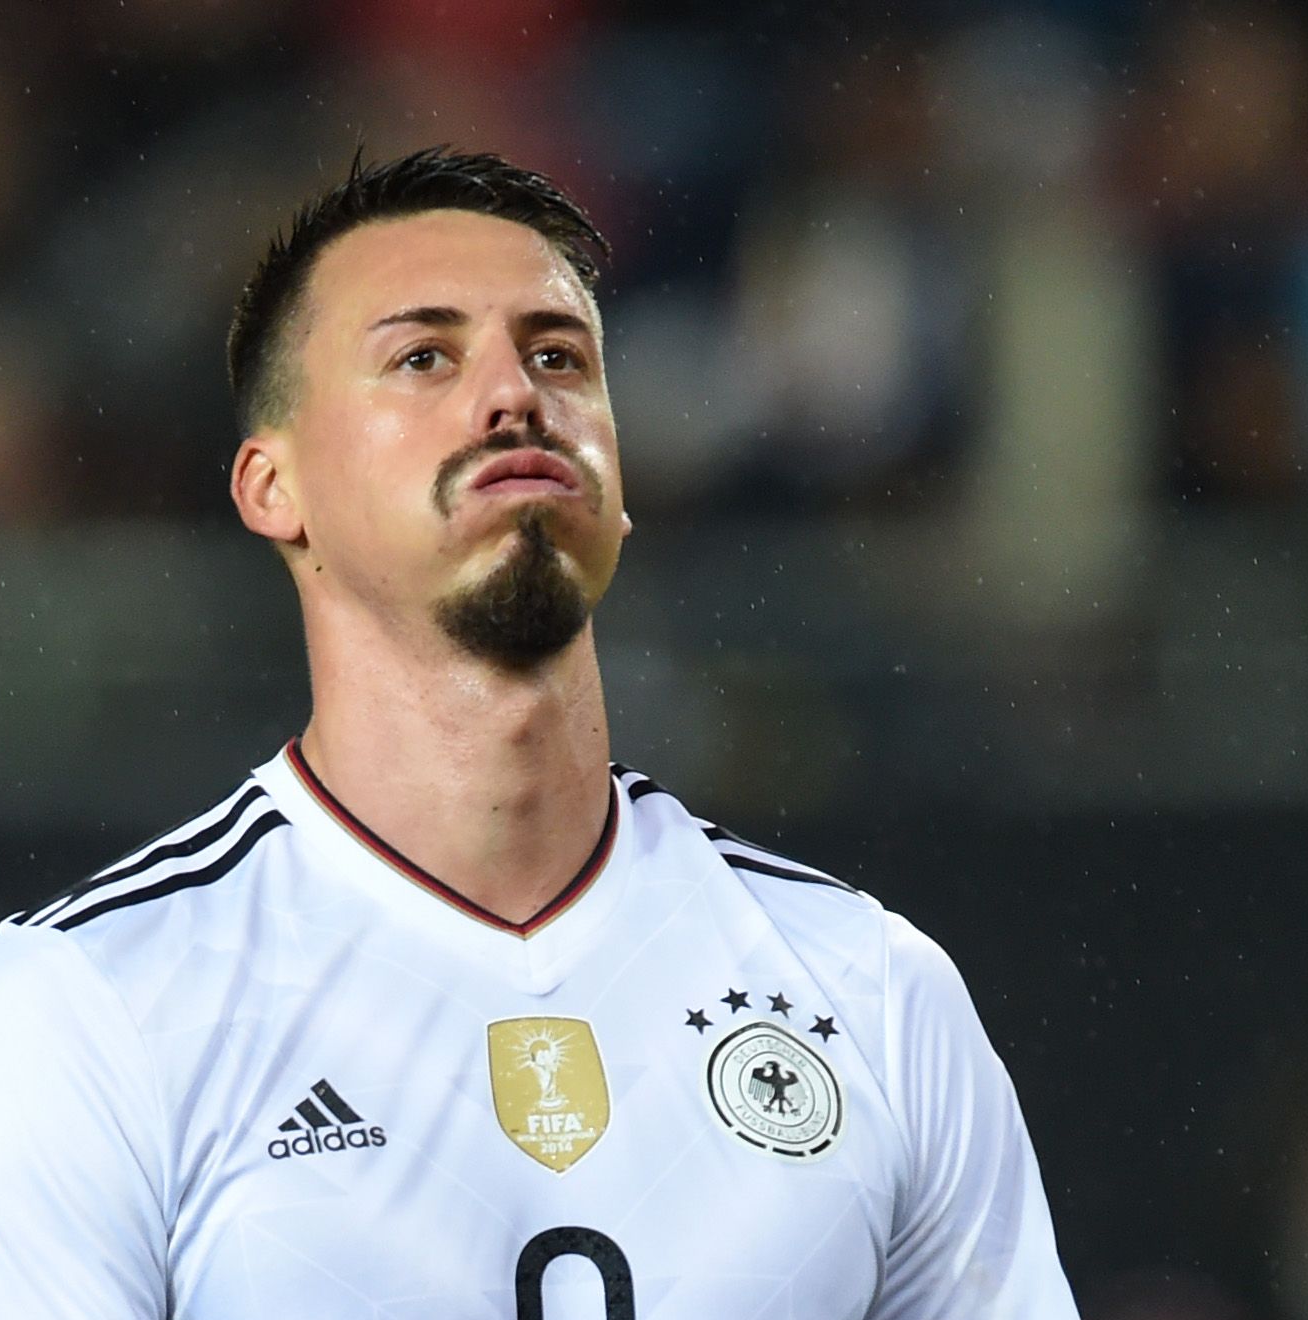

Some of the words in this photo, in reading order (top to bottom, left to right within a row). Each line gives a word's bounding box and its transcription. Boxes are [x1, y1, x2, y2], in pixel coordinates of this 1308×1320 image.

[528, 1113, 582, 1134] FIFA
[267, 1126, 387, 1160] adidas
[540, 1141, 573, 1154] 2014
